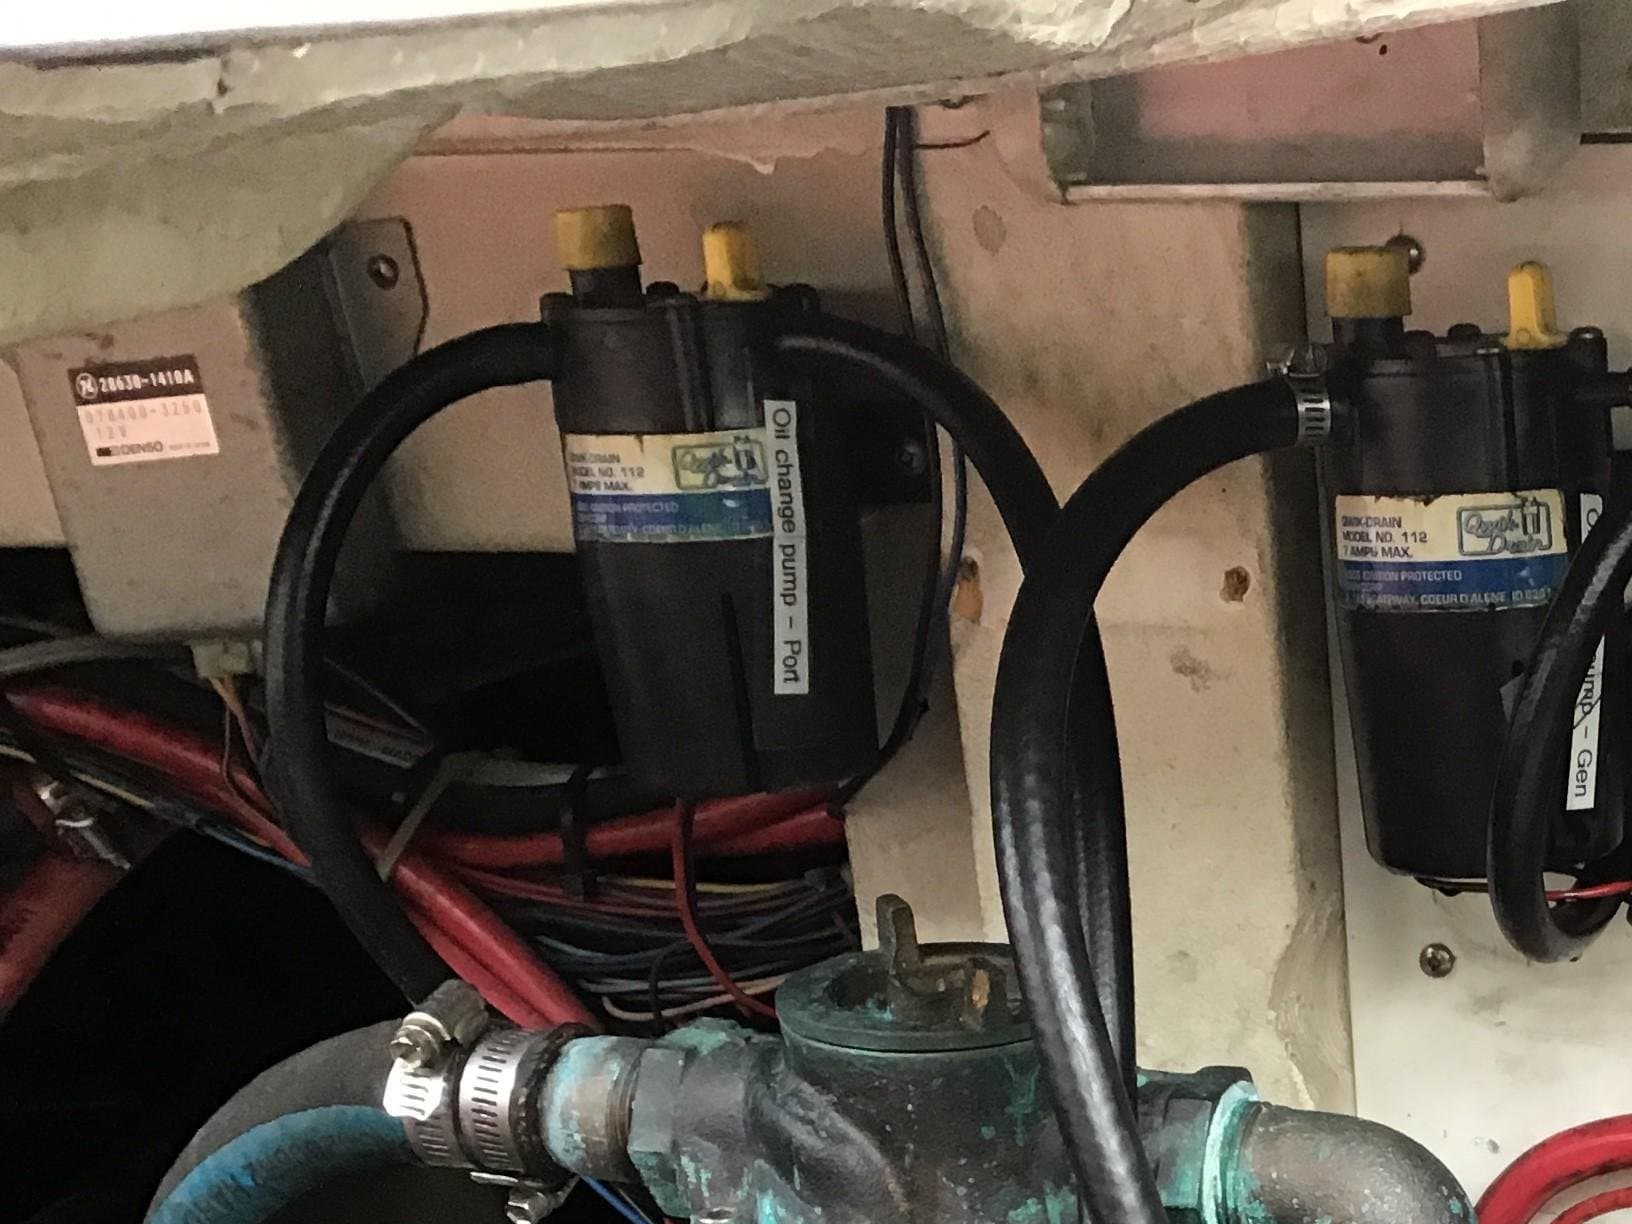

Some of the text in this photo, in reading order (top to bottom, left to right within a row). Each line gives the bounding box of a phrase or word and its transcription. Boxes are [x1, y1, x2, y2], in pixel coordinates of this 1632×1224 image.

[773, 408, 791, 439] Oil
[774, 449, 796, 532] change
[1401, 531, 1428, 543] 112
[779, 544, 797, 607] pump
[1400, 570, 1462, 581] PROTECTED
[782, 640, 801, 683] Port
[1575, 749, 1593, 797] Gen
